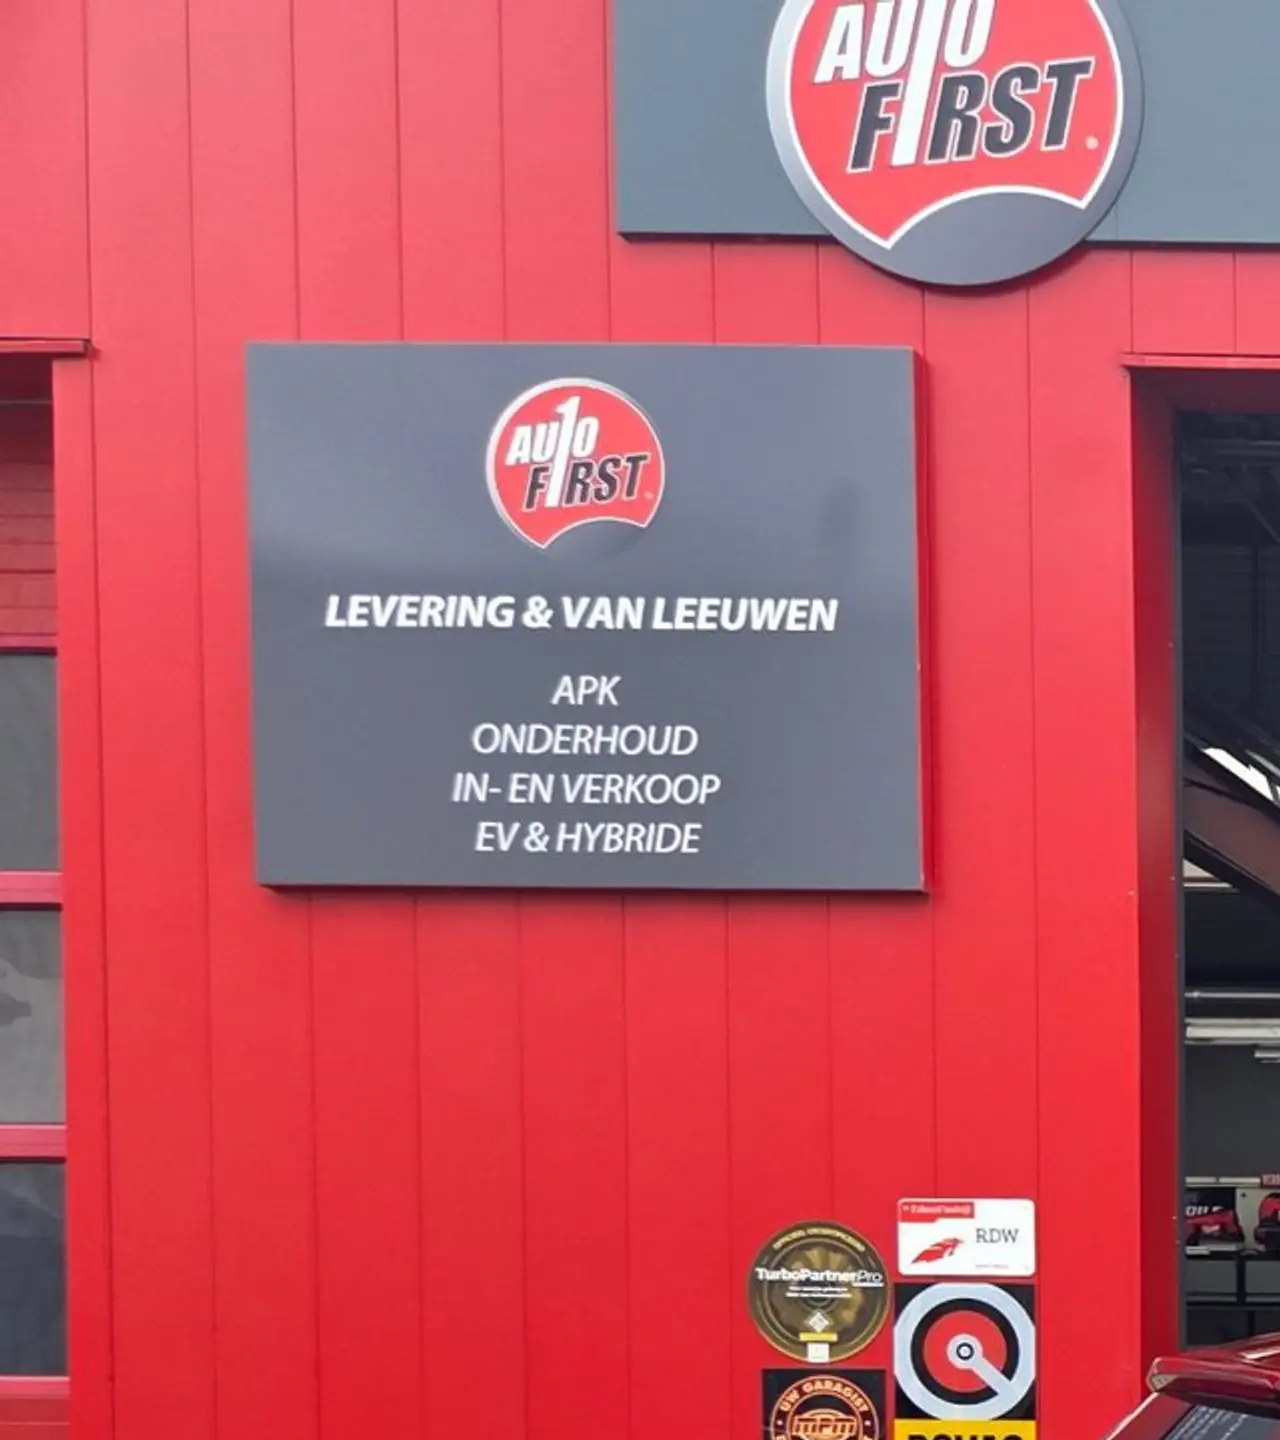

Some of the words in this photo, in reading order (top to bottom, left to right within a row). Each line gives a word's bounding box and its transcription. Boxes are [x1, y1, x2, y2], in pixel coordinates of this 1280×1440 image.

[324, 594, 516, 629] LEVERING
[522, 595, 554, 629] &
[562, 597, 650, 631] VAN
[651, 597, 839, 632] LEEUWEN
[550, 674, 622, 706] APK
[471, 722, 699, 756] ONDERHOUD
[451, 772, 503, 803] IN-
[507, 773, 555, 804] EN
[561, 773, 722, 805] VERKOOP
[475, 821, 521, 852] EV
[523, 821, 550, 853] &
[556, 822, 703, 854] HYBRIDE
[975, 1227, 1019, 1244] RDW
[779, 1388, 801, 1412] UW
[801, 1379, 869, 1412] GARAGIST
